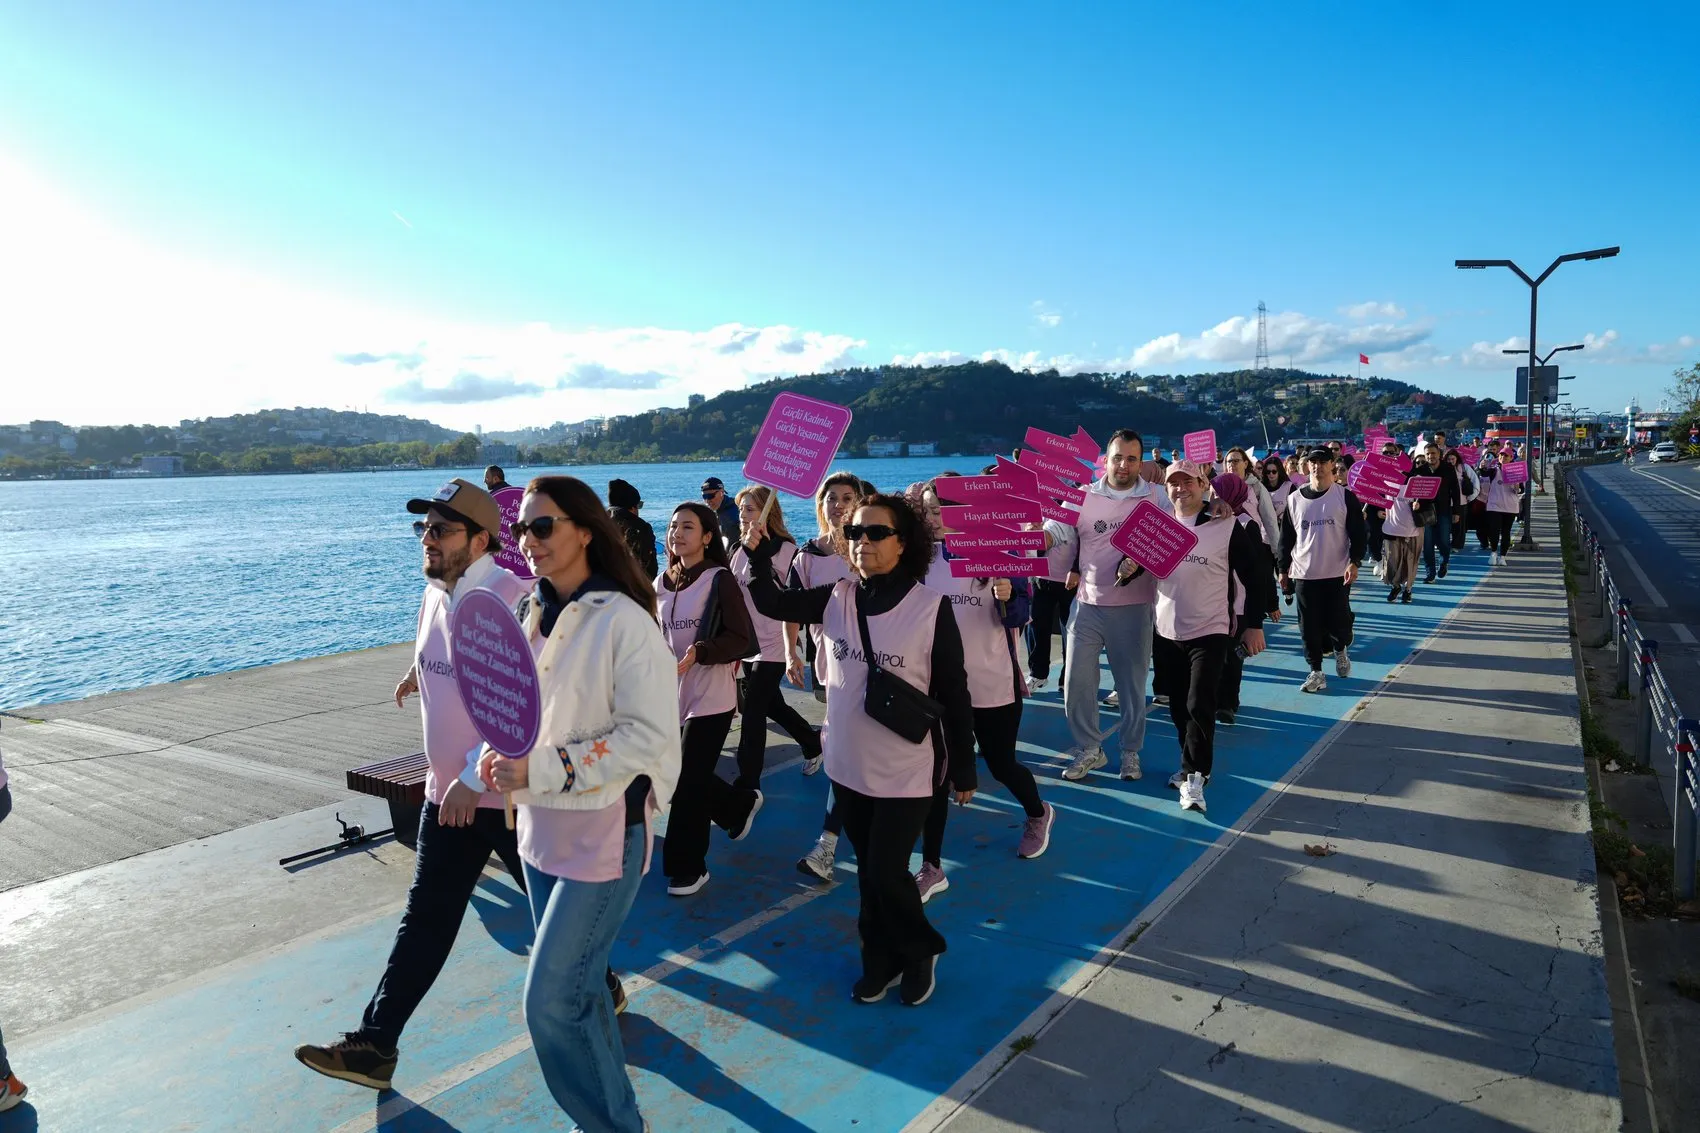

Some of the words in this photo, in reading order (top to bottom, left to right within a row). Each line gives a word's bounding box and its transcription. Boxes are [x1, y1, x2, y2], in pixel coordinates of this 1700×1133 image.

[782, 405, 804, 421] Güçlü
[803, 412, 834, 430] Kadınlar,
[775, 420, 797, 435] Güçlü
[797, 426, 829, 444] Yaşamlar
[768, 436, 792, 451] Meme
[791, 442, 820, 459] Kanseri
[1045, 437, 1065, 448] Erken
[1066, 443, 1081, 454] Tanı,
[763, 447, 812, 471] Farkındalığına
[1035, 459, 1055, 471] Hayat
[1054, 465, 1081, 478] Kurtarır
[762, 461, 788, 478] Destek
[788, 470, 804, 482] Ver!
[964, 481, 990, 491] Erken
[991, 480, 1014, 490] Tanı,
[1066, 490, 1082, 502] Karşı
[964, 512, 991, 522] Hayat
[991, 511, 1027, 520] Kurtarır
[1041, 504, 1068, 519] üçlüyüz!
[1138, 518, 1155, 534] Güçlü
[1155, 530, 1180, 551] Yaşamlar
[1144, 511, 1162, 527] Güçlü
[1161, 522, 1186, 544] Kadınlar,
[950, 539, 977, 547] Meme
[978, 538, 1020, 547] Kanserine
[1020, 537, 1042, 547] Karşı
[1127, 534, 1166, 563] Farkındalığına
[1132, 526, 1151, 543] Meme
[1150, 539, 1173, 557] Kanseri
[1126, 541, 1147, 559] Destek
[1146, 554, 1159, 567] Ver!
[1183, 553, 1209, 566] DİPOL
[965, 563, 993, 573] Birlikte
[992, 562, 1034, 574] Güçlüyüz!
[950, 593, 983, 607] EDİPOL
[475, 612, 503, 637] Pembe
[667, 618, 701, 630] MEDİPO
[461, 624, 474, 640] Bir
[473, 629, 505, 653] Gelecek
[504, 639, 521, 663] İçin
[455, 638, 487, 666] Kendine
[486, 653, 515, 680] Zaman
[514, 667, 533, 690] Ayır
[461, 664, 487, 687] Meme
[486, 676, 528, 709] Kanseriyle
[471, 685, 520, 722] Mücadelede
[471, 702, 487, 722] Sen
[486, 709, 498, 728] de
[497, 715, 512, 735] Var
[511, 723, 526, 743] Ol!
